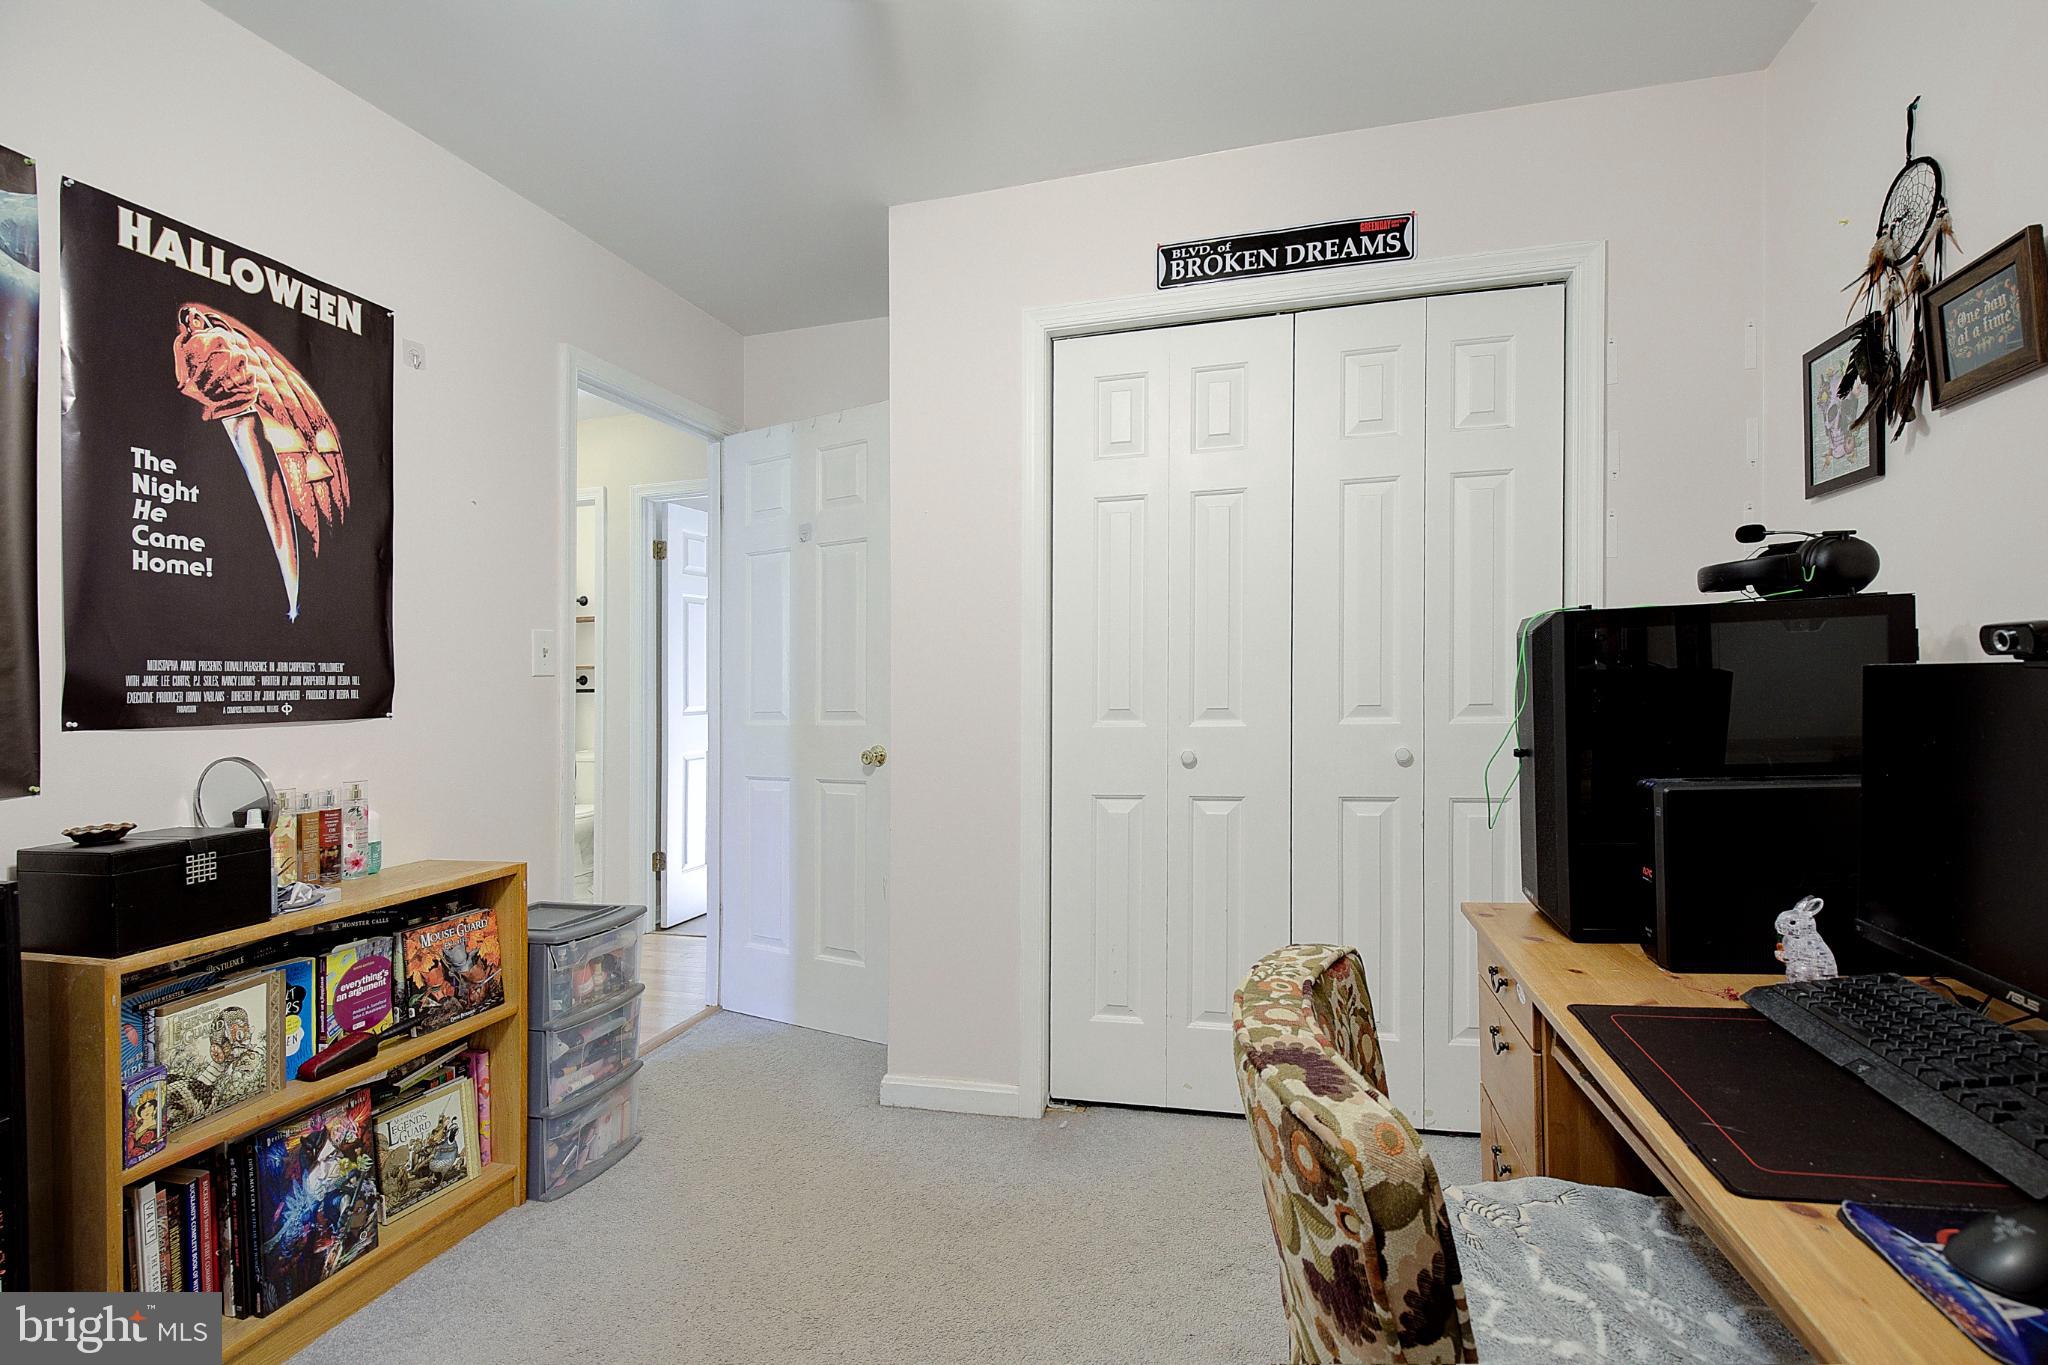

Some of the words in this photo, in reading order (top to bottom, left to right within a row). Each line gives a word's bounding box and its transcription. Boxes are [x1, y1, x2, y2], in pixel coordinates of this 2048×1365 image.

[1170, 247, 1279, 281] BROKEN
[1285, 231, 1401, 267] DREAMS
[1172, 245, 1214, 259] BLVD.
[1217, 241, 1232, 253] of
[117, 204, 362, 336] HALLOWEEN
[1957, 308, 1980, 328] One
[1983, 293, 2007, 315] day
[1957, 326, 1969, 346] at
[1972, 326, 1981, 338] a
[1982, 309, 2011, 332] time
[130, 446, 177, 475] The
[132, 472, 200, 504] Night
[132, 498, 168, 523] He
[131, 524, 206, 552] Came
[132, 549, 213, 578] Home!
[199, 661, 223, 672] PRESENTS
[276, 661, 288, 672] JOHN
[125, 675, 139, 687] WITH
[142, 675, 159, 687] JAMIE
[161, 675, 170, 687] LEE
[282, 675, 289, 686] BY
[290, 675, 302, 686] JOHN
[126, 691, 154, 704] EXECUTIVE
[156, 691, 184, 703] PRODUCER
[254, 690, 260, 701] BY
[263, 690, 275, 701] JOHN
[328, 689, 335, 700] BY
[341, 919, 370, 929] MONSTER
[371, 917, 390, 925] CALLS
[419, 927, 455, 949] MOUSE
[456, 918, 488, 937] GUARD
[336, 992, 347, 1003] an
[348, 978, 387, 997] argument
[341, 968, 389, 992] everything's
[2006, 990, 2040, 1013] ASUS
[183, 1019, 225, 1046] GUARD
[385, 1111, 428, 1147] LEGENDS
[399, 1120, 432, 1144] GUARD
[138, 1147, 157, 1162] TAROT
[189, 1182, 197, 1221] BUCKLAND'S
[145, 1202, 156, 1240] VALVE
[190, 1221, 198, 1252] COMPLETE
[192, 1270, 198, 1279] OF
